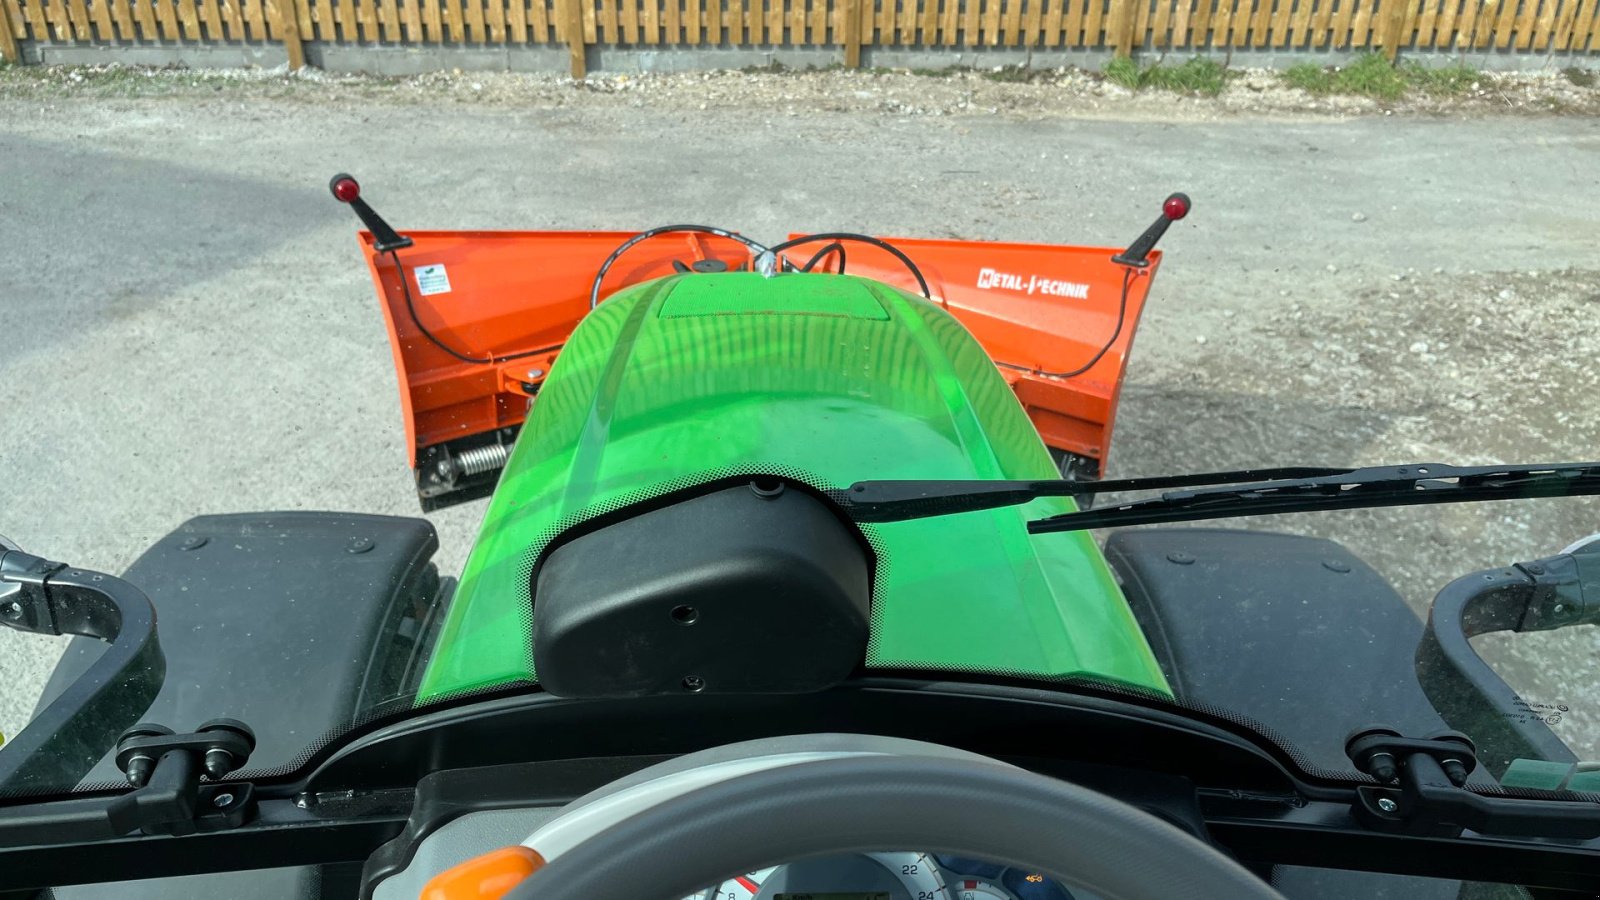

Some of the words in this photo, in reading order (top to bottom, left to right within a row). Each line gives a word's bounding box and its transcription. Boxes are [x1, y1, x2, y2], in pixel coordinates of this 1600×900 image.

[902, 864, 918, 875] 22
[728, 892, 736, 900] 8
[918, 891, 934, 900] 24
